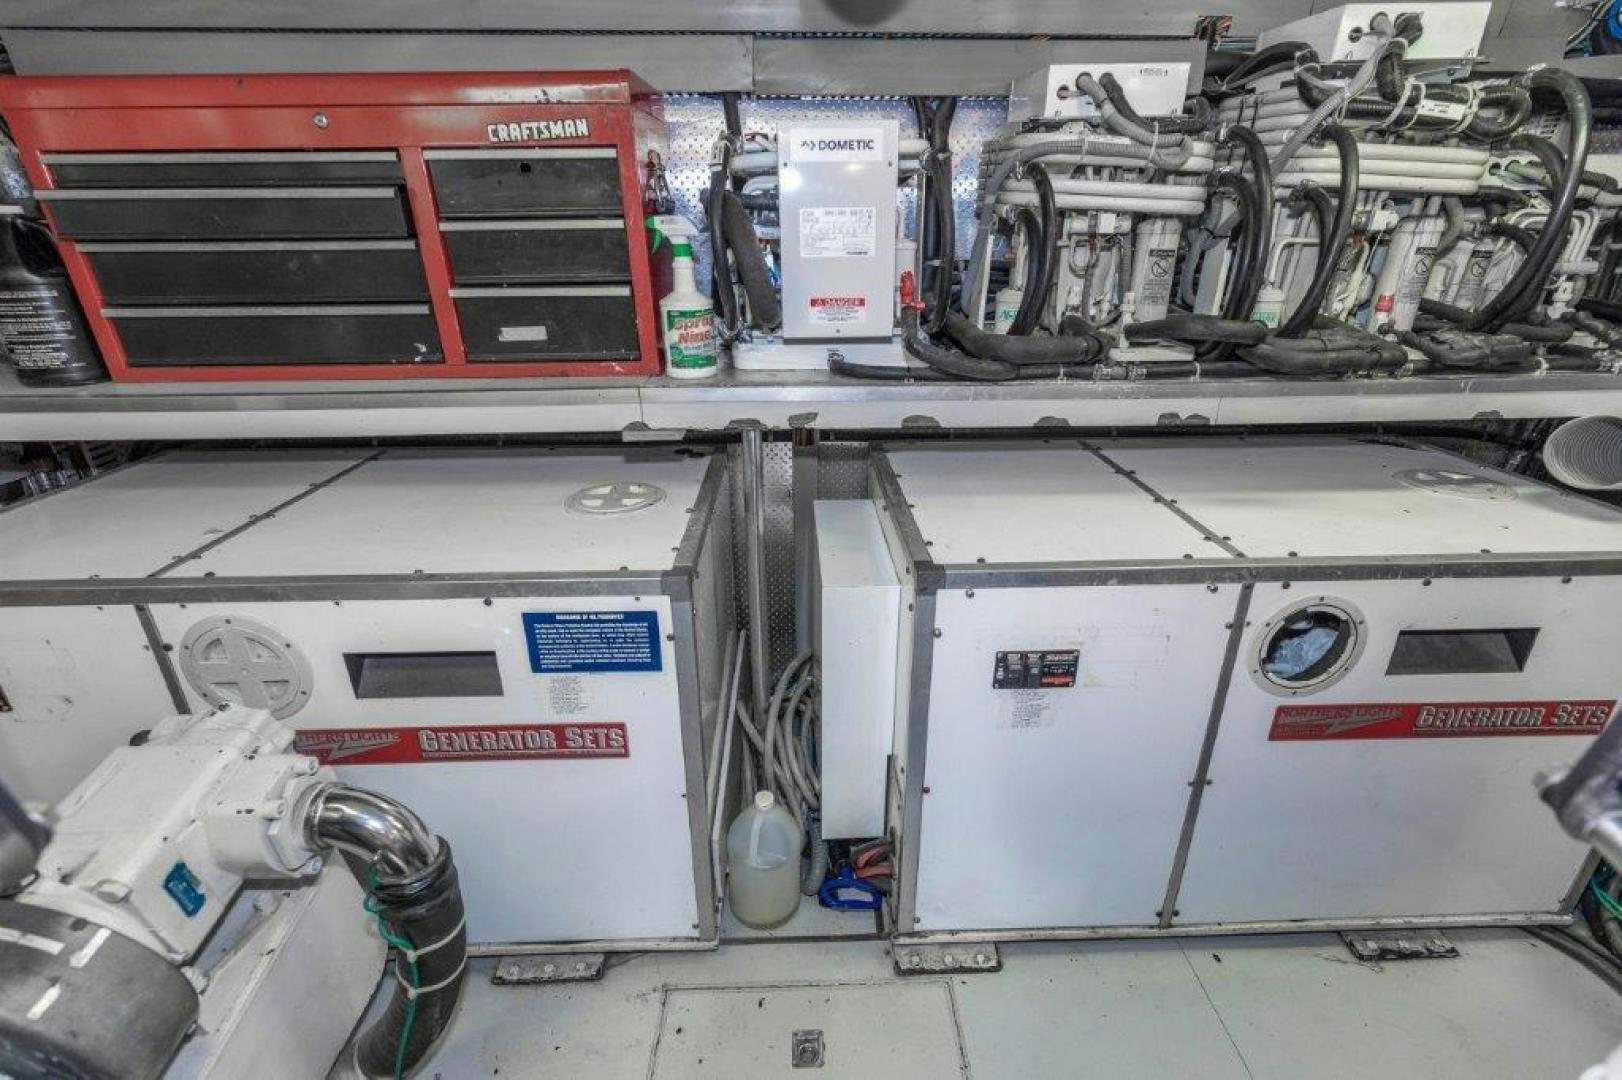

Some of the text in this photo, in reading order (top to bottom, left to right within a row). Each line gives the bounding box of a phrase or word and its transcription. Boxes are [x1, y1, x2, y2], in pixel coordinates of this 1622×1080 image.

[487, 118, 589, 143] CRAFTSMAN
[818, 139, 875, 151] DOMETIC
[1415, 704, 1610, 728] GENERATOR SETS
[417, 727, 626, 751] GENERATOR SETS
